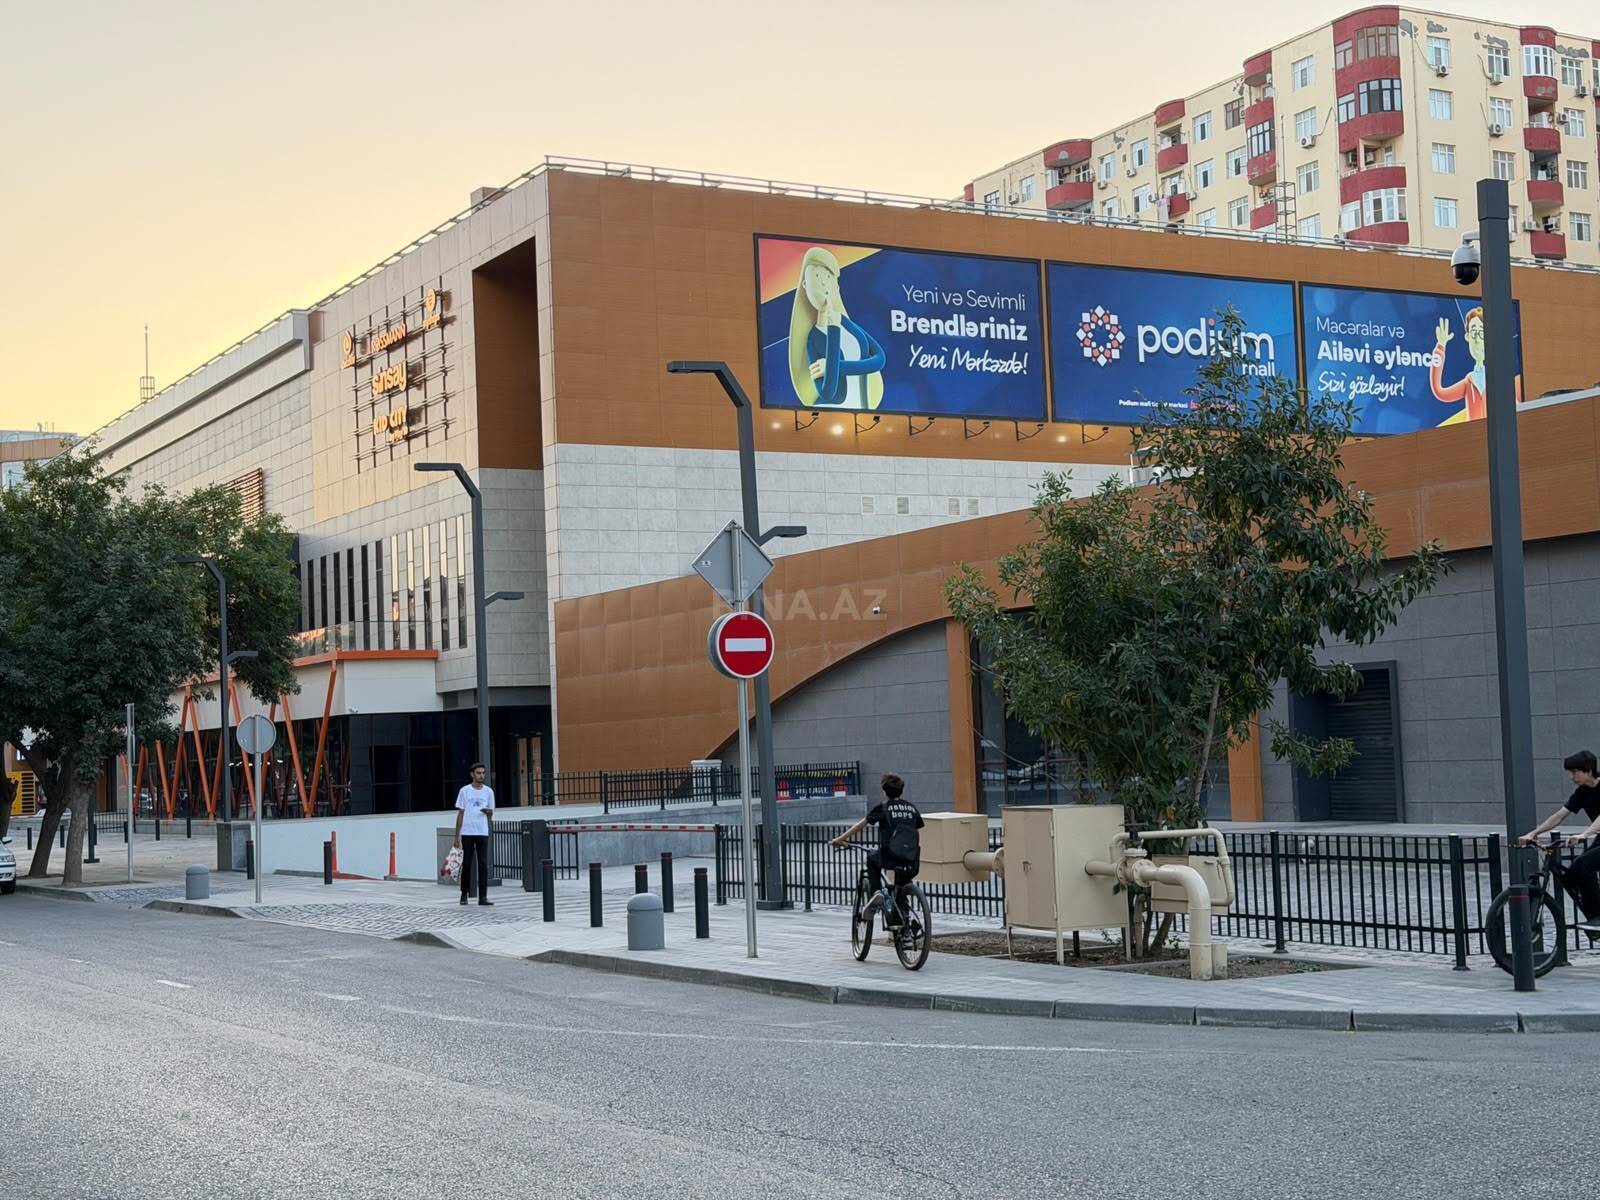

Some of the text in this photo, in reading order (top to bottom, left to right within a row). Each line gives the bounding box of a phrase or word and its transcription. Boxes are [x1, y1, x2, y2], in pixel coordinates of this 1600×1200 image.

[902, 284, 1026, 312] Yeni və Sevimli
[891, 310, 1028, 341] Brendləriniz
[1137, 317, 1275, 363] podium
[1316, 316, 1405, 339] Macəralar və
[909, 345, 1029, 375] Yeni Mərkəzdə!
[1242, 362, 1276, 376] mall
[1318, 340, 1442, 370] Ailəvi əyləncə
[372, 361, 407, 395] sinsay
[1318, 371, 1405, 401] Sizi gözləyir!
